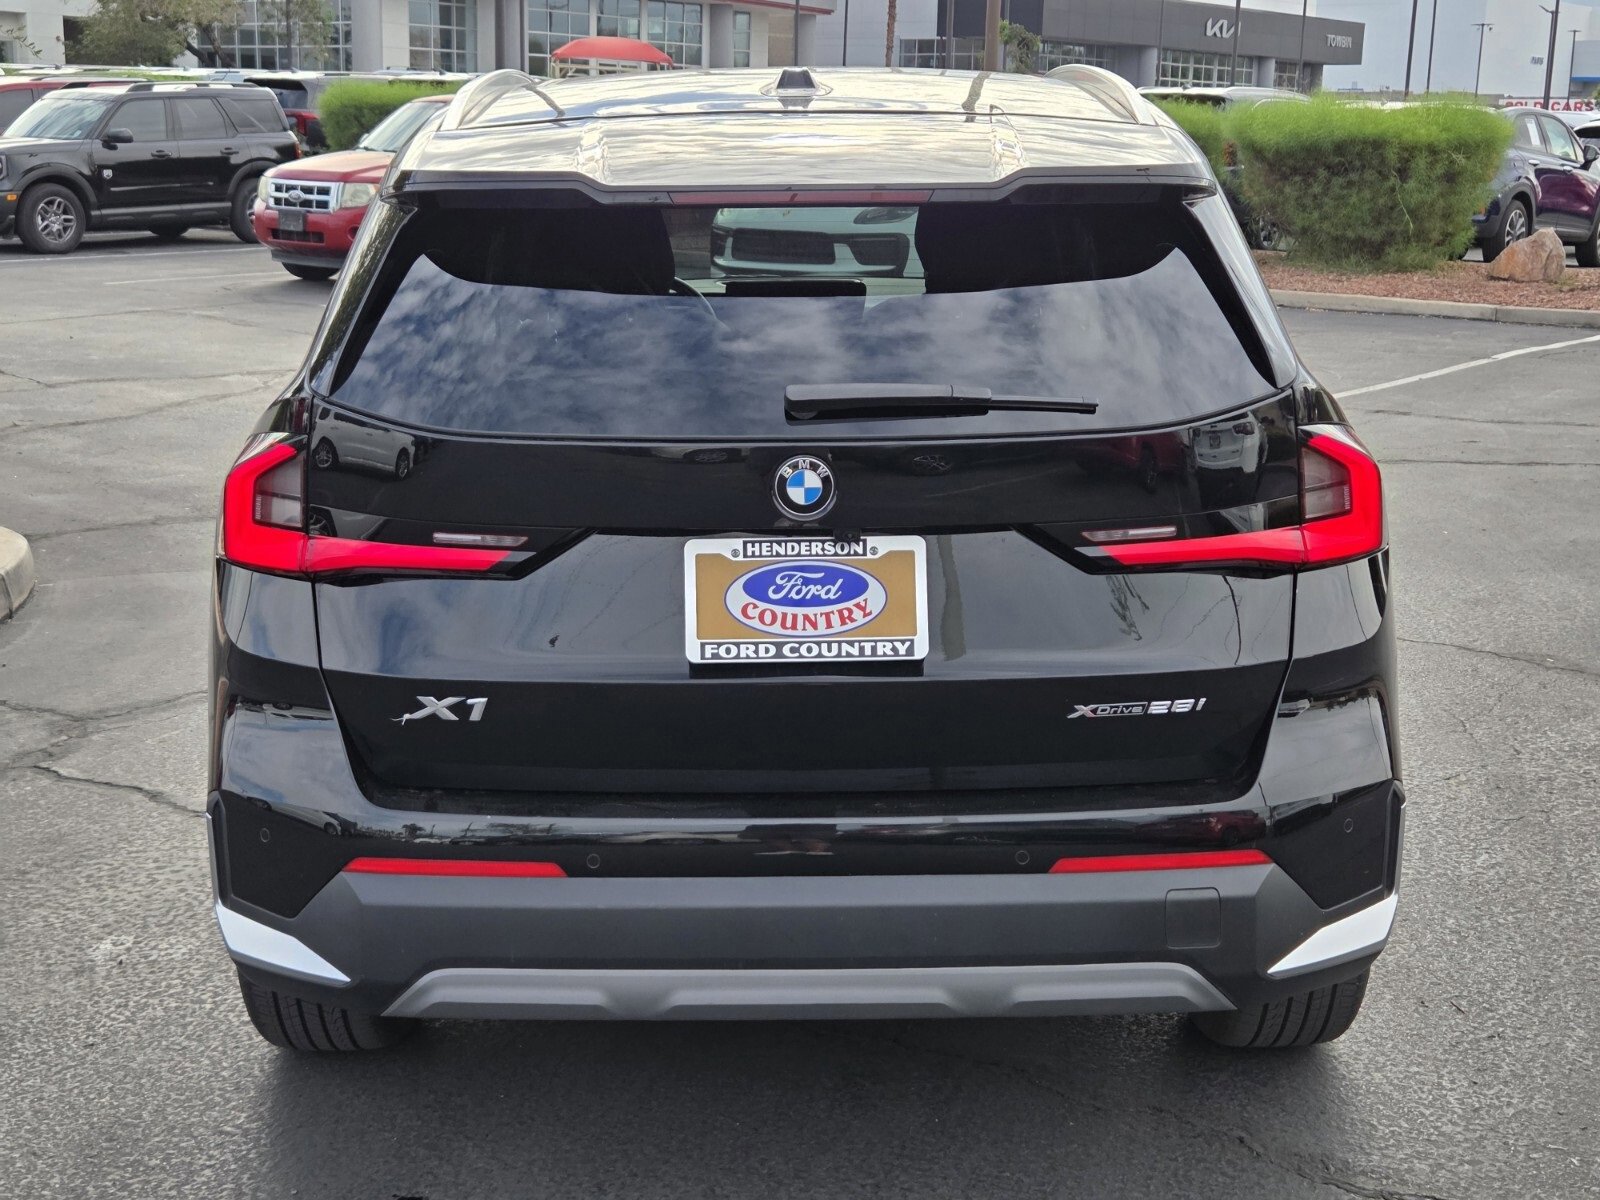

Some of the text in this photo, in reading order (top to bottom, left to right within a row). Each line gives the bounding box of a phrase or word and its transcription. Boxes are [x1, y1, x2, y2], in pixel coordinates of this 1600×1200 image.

[1326, 34, 1352, 48] TOWBIN
[1551, 101, 1594, 112] CARS
[781, 459, 830, 479] BMW
[746, 541, 863, 556] HENDERSON
[768, 571, 843, 600] Ford
[740, 598, 873, 631] COUNTRY
[704, 641, 912, 659] FORD COUNTRY
[403, 696, 488, 721] X1
